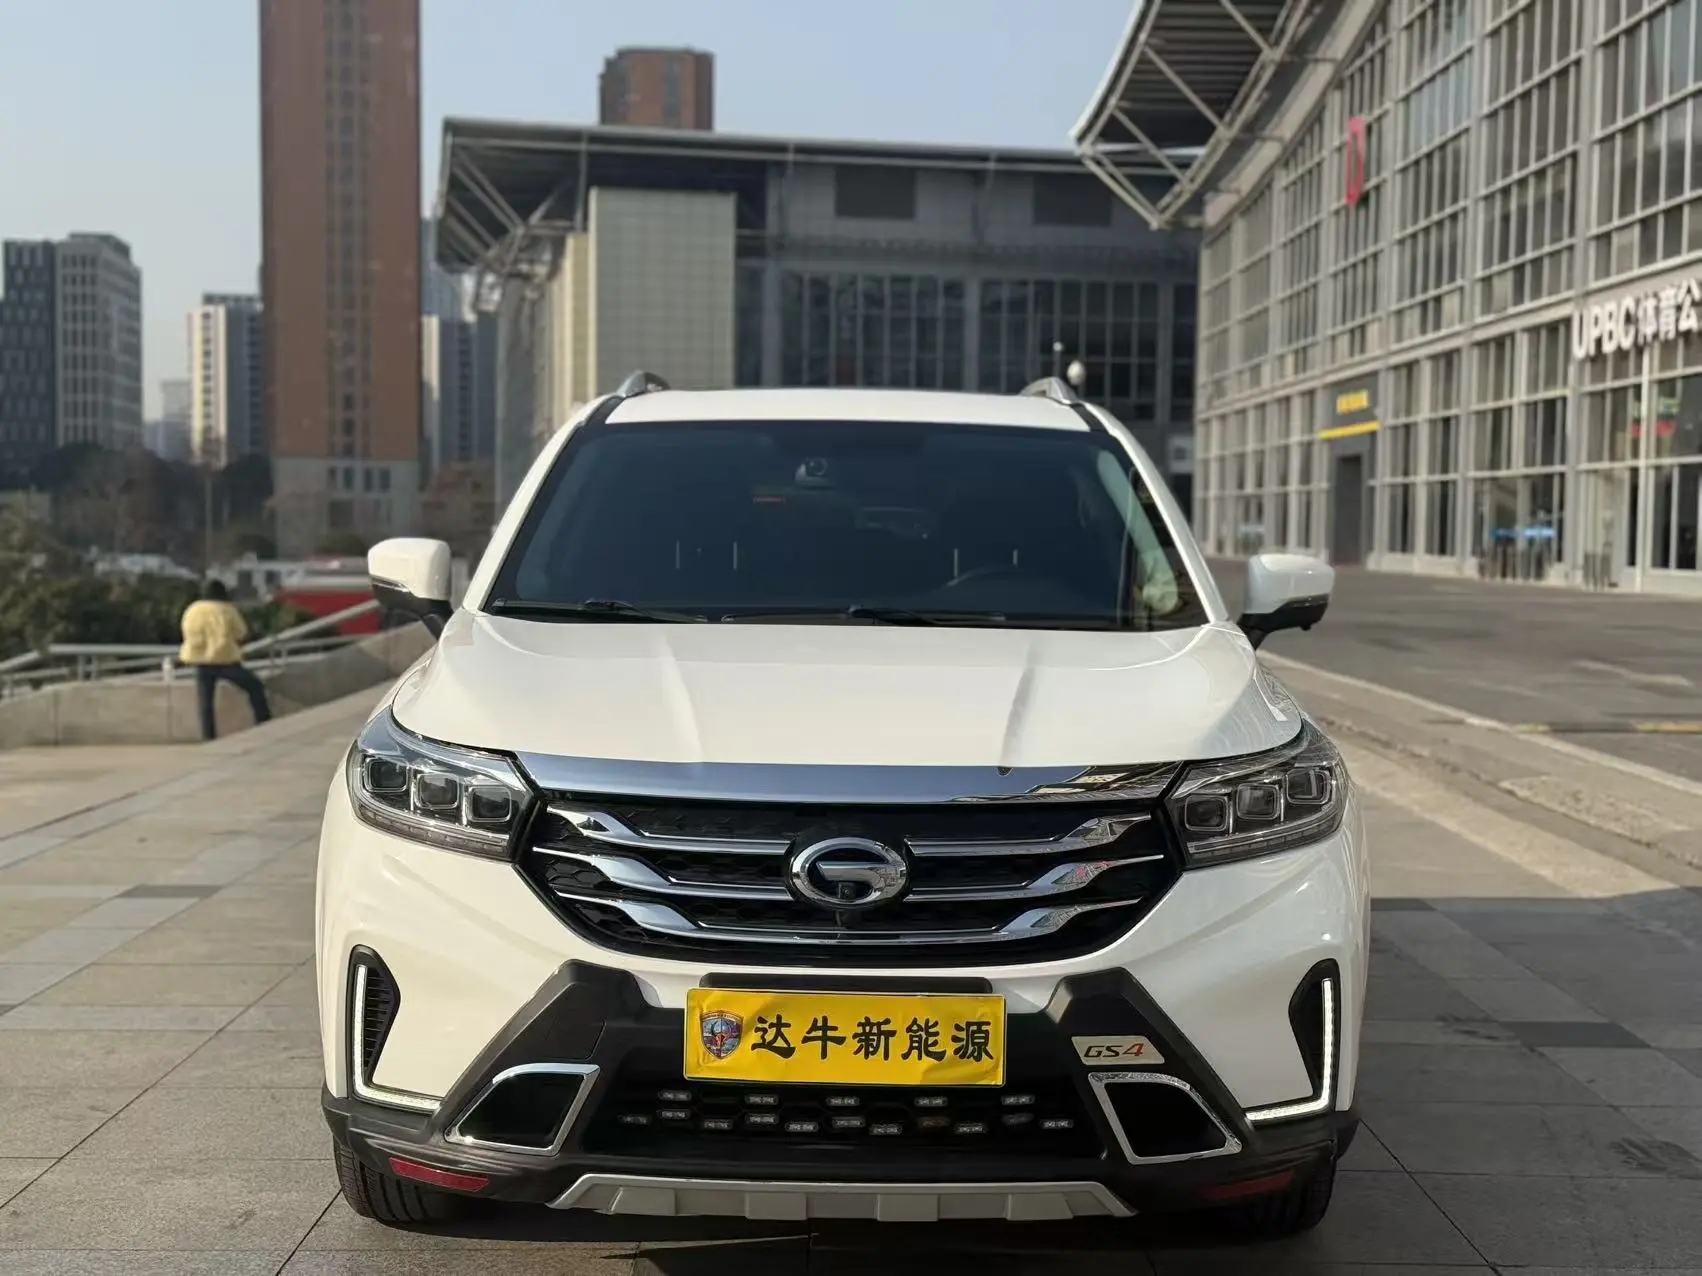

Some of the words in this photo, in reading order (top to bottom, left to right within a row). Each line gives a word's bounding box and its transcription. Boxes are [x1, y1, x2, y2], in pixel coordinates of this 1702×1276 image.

[751, 1014, 995, 1062] 达牛新能源
[1084, 1043, 1144, 1057] GS4
